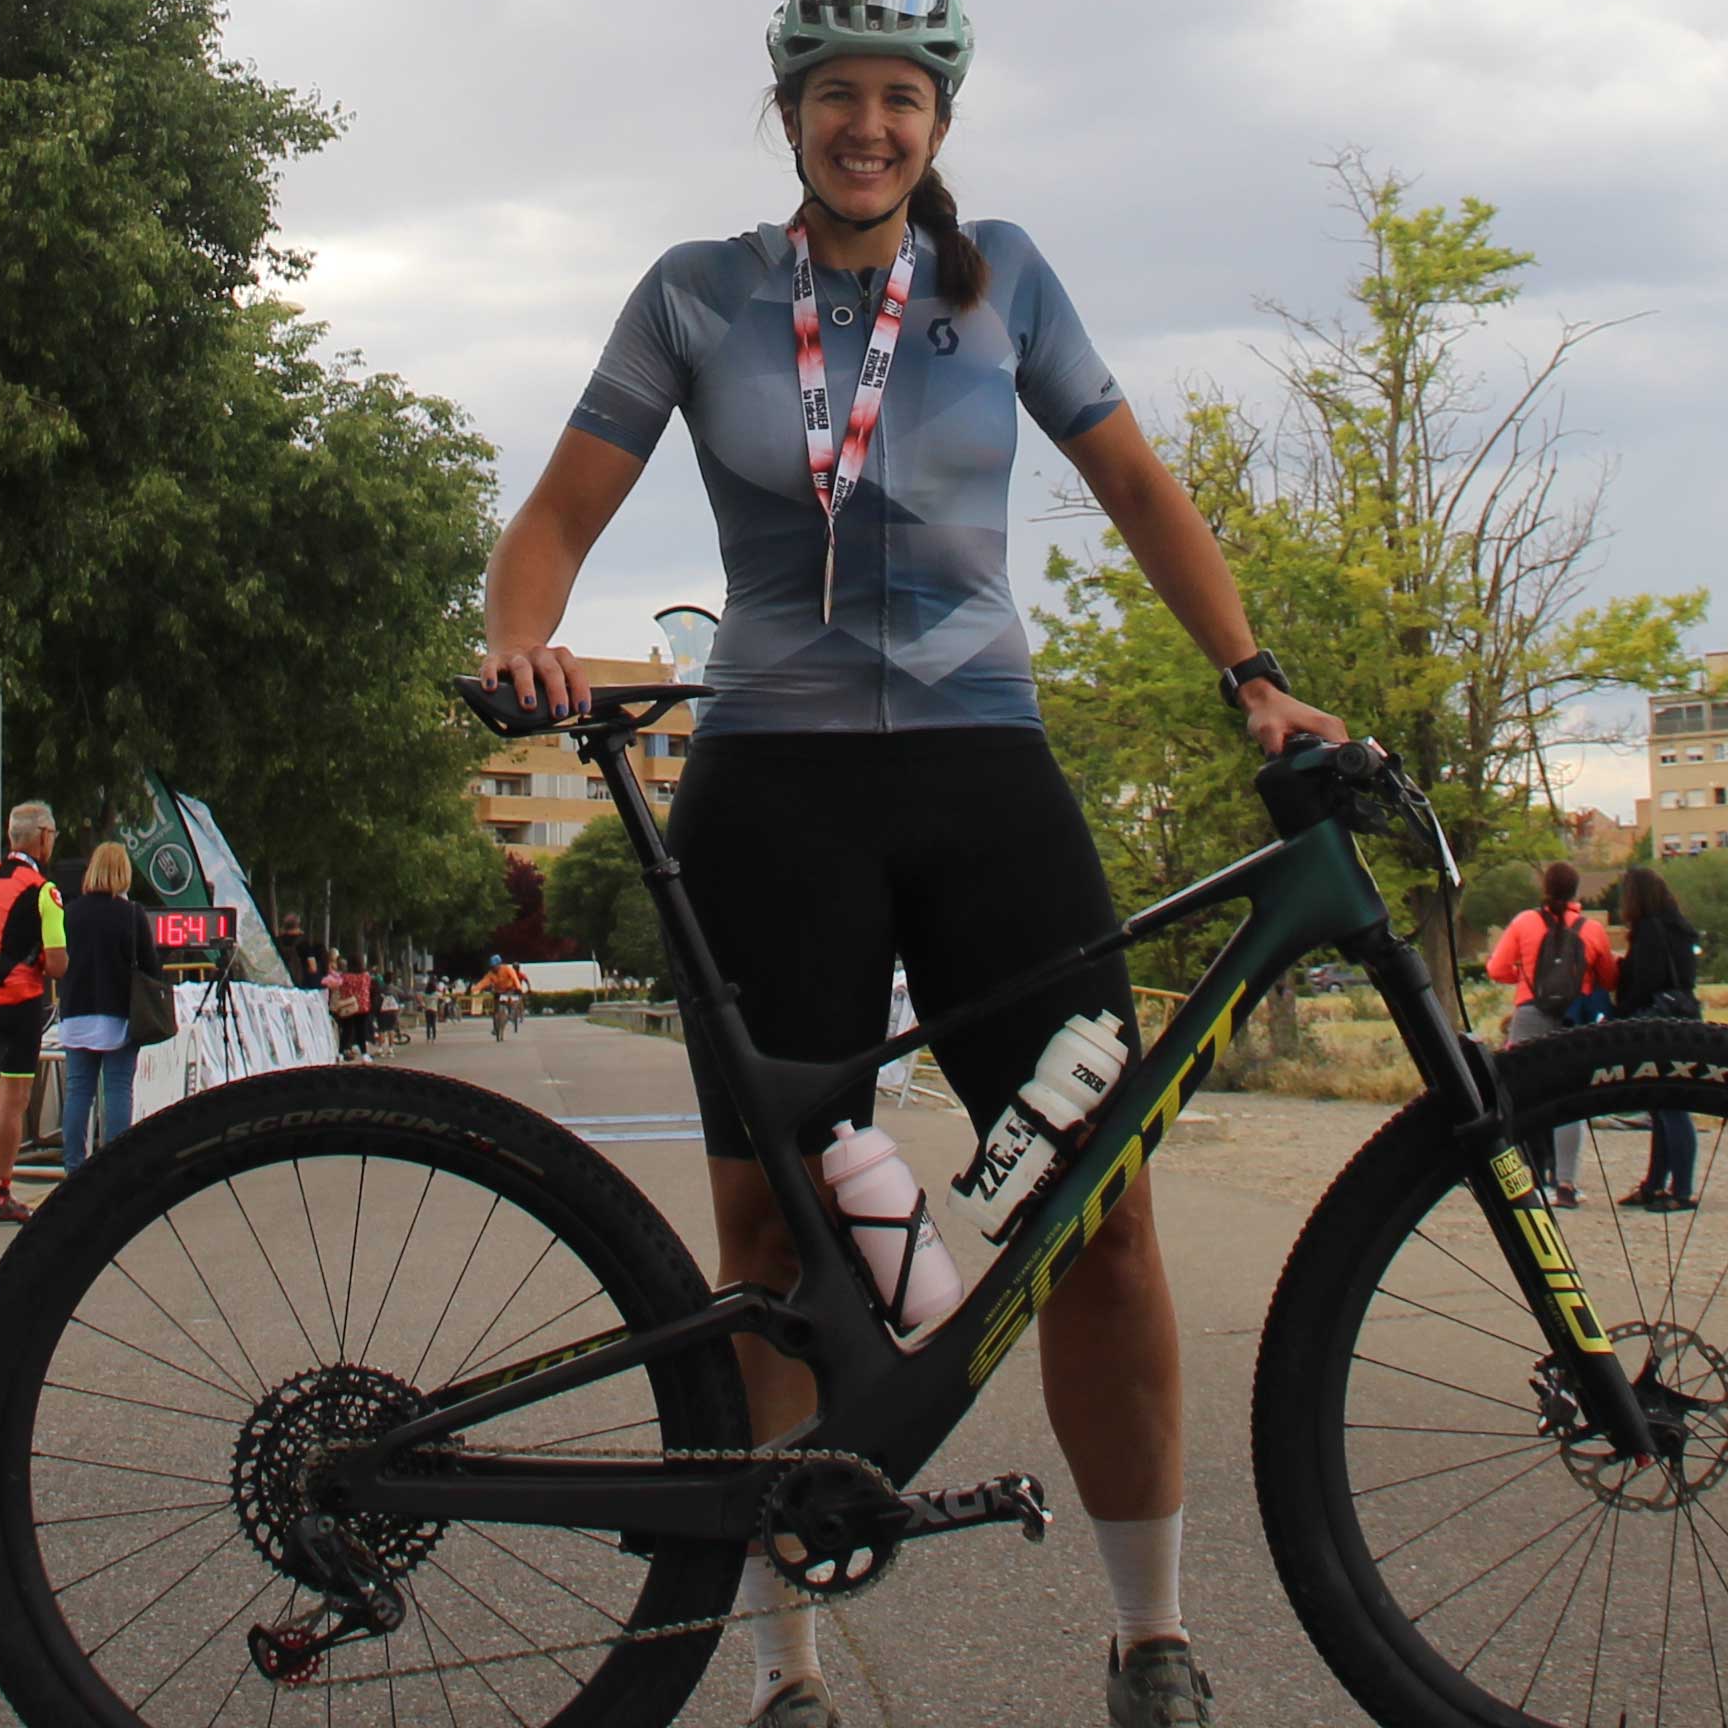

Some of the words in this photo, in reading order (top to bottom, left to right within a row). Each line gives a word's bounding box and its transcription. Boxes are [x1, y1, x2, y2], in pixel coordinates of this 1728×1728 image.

[861, 347, 881, 387] FINISHER
[813, 387, 829, 430] FINISHER
[224, 1108, 452, 1139] SCORPION
